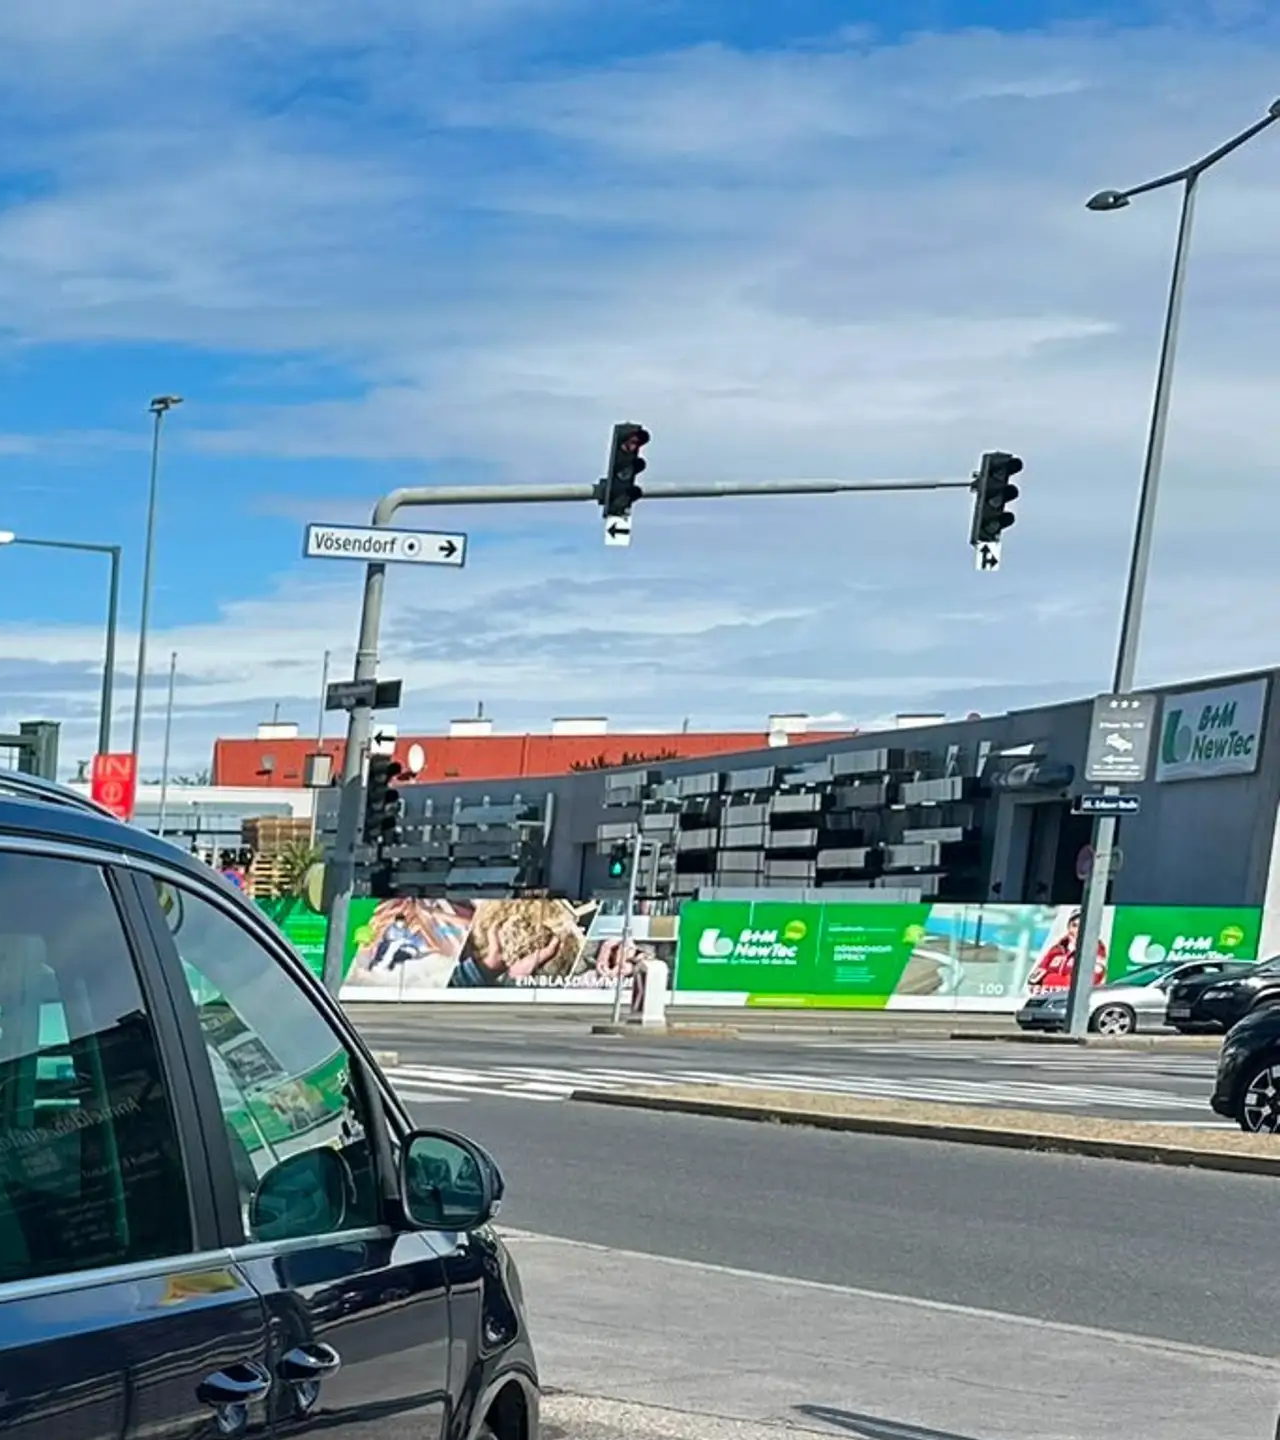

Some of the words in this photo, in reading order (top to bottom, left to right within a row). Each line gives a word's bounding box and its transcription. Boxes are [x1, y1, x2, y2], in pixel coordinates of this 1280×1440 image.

[314, 531, 398, 554] Vösendorf
[1197, 702, 1237, 731] B+M
[1192, 731, 1255, 762] NewTec
[739, 928, 779, 943] B+M
[734, 942, 799, 958] NewTec
